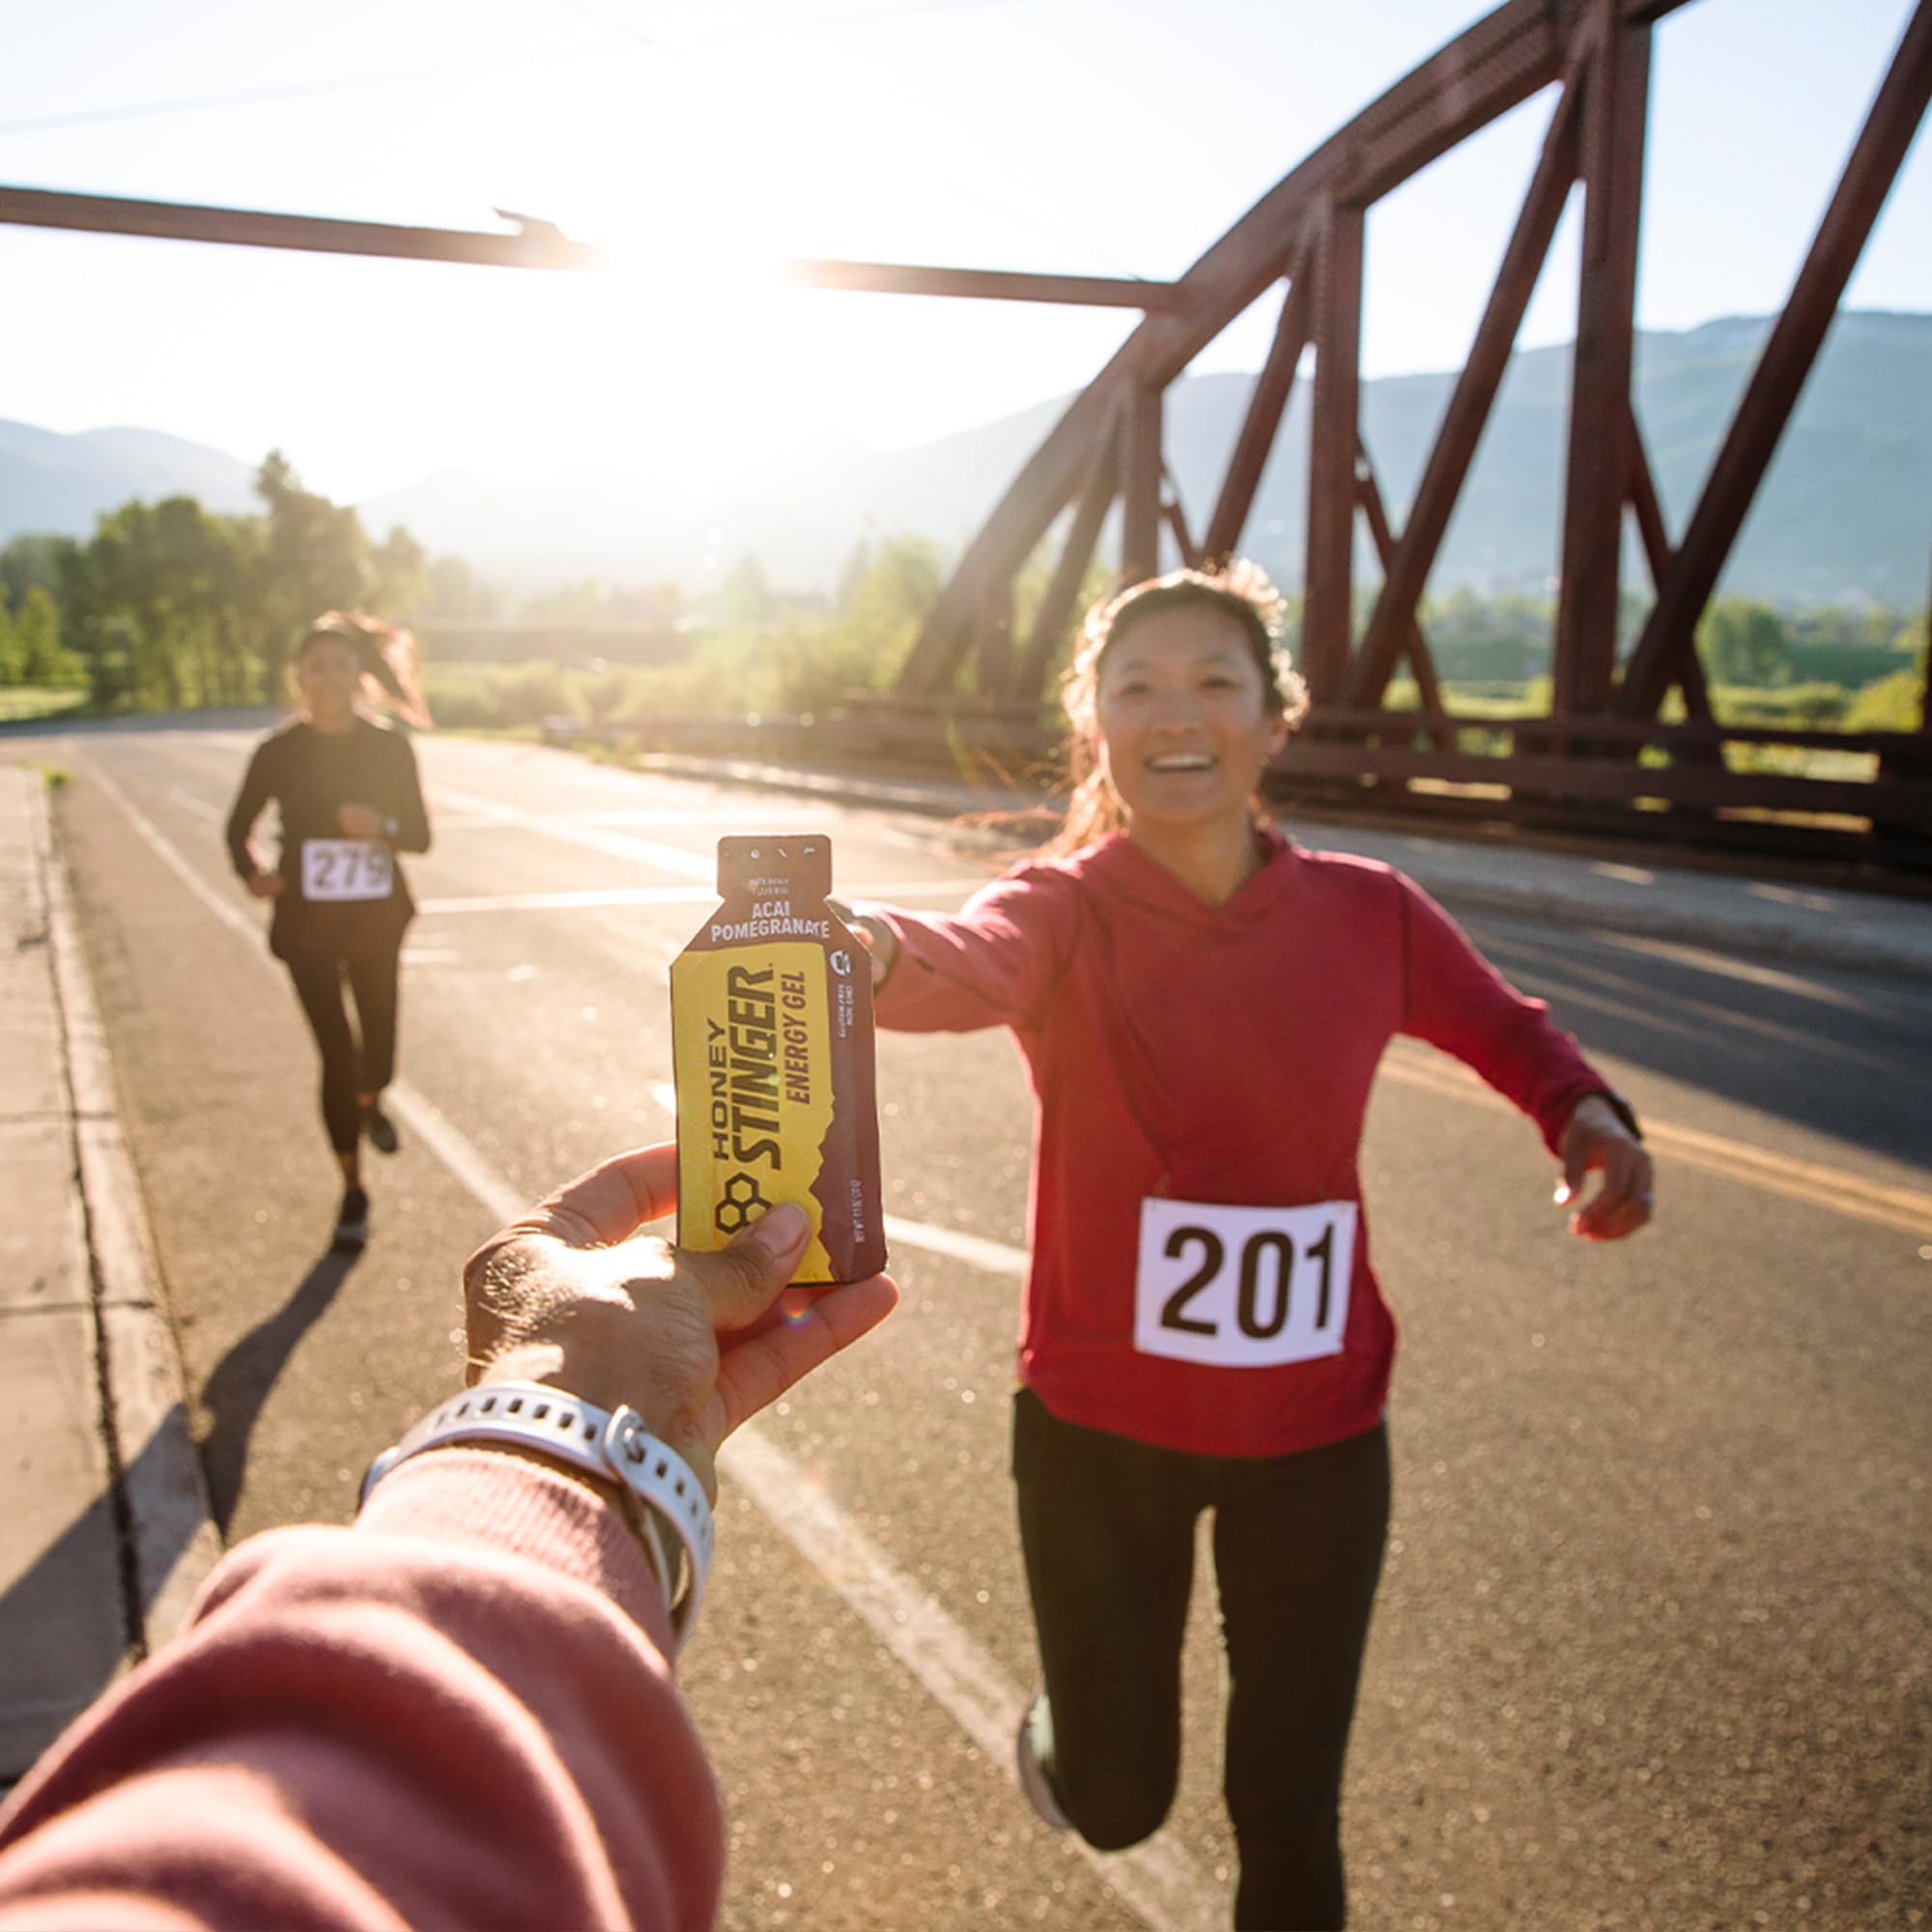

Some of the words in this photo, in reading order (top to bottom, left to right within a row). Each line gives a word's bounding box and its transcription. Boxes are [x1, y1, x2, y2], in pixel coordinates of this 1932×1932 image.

[314, 849, 392, 889] 279
[711, 918, 831, 942] POMEGRANATE
[752, 900, 790, 919] ACAI
[781, 970, 807, 1010] GEL
[707, 1017, 728, 1160] HONEY
[727, 965, 781, 1171] STINGER
[781, 1012, 811, 1105] ENERGY
[1160, 1222, 1333, 1340] 201
